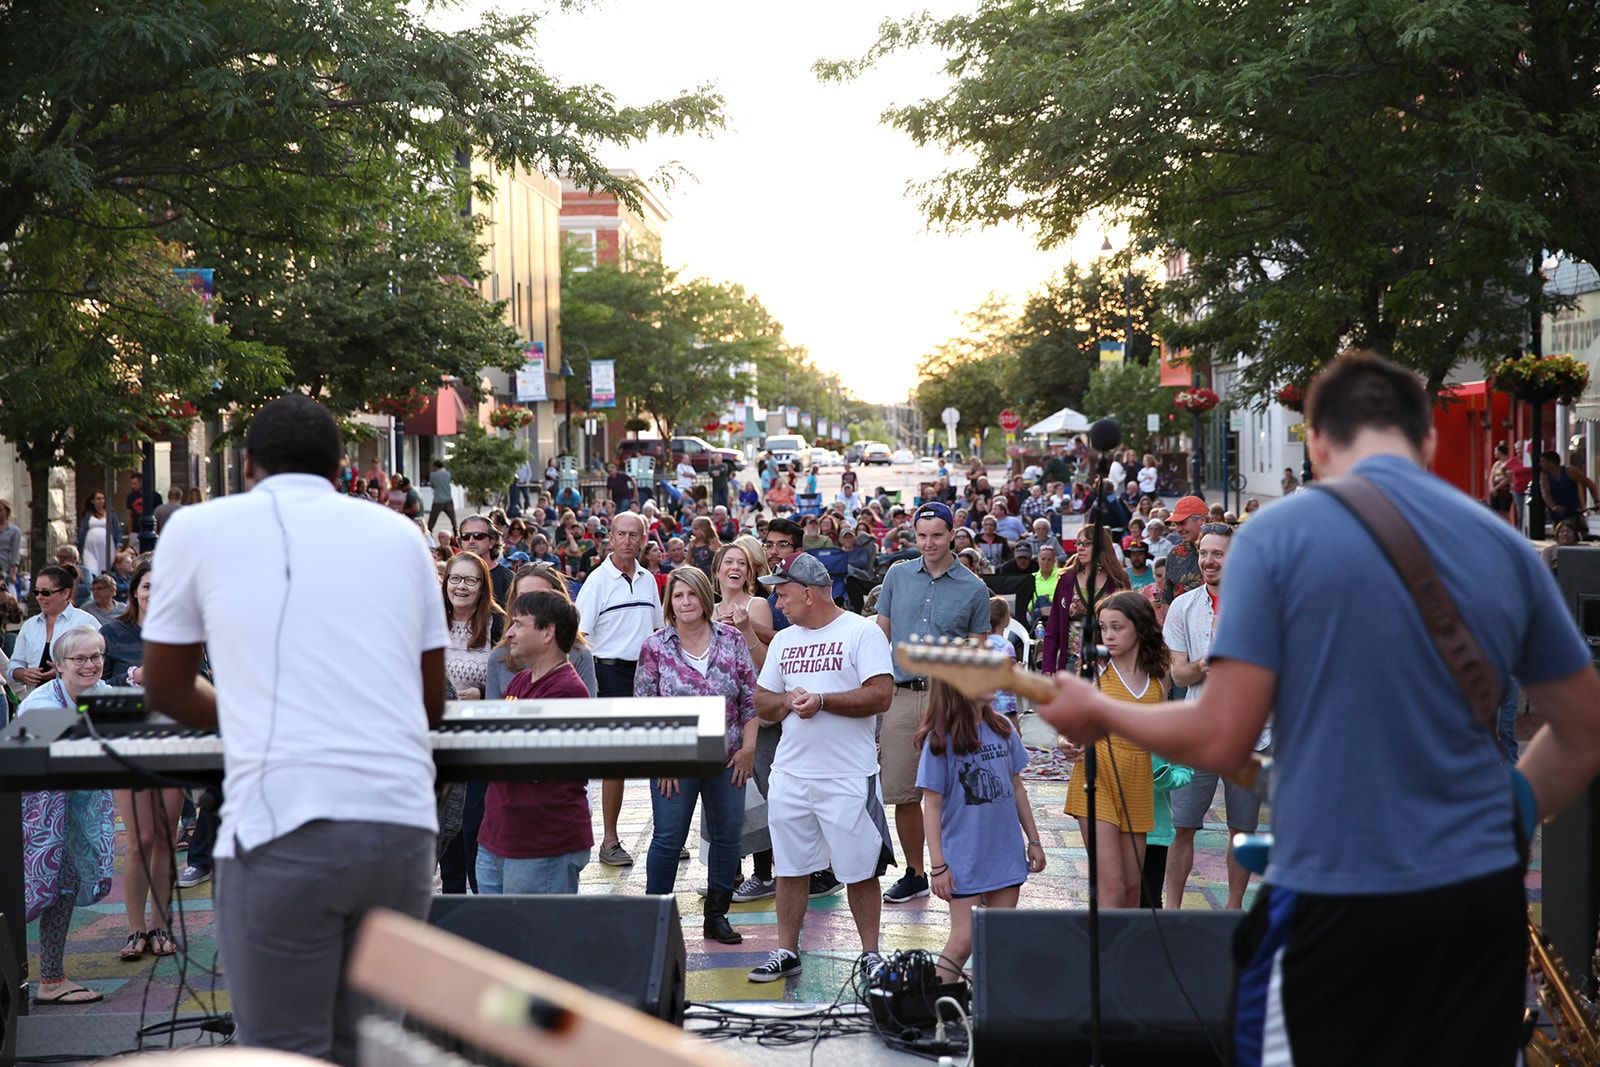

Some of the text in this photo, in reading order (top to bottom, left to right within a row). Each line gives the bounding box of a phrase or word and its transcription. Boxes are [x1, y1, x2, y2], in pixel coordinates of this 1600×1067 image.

[781, 642, 843, 661] CENTRAL
[780, 658, 843, 675] MICHIGAN
[981, 751, 994, 761] THE
